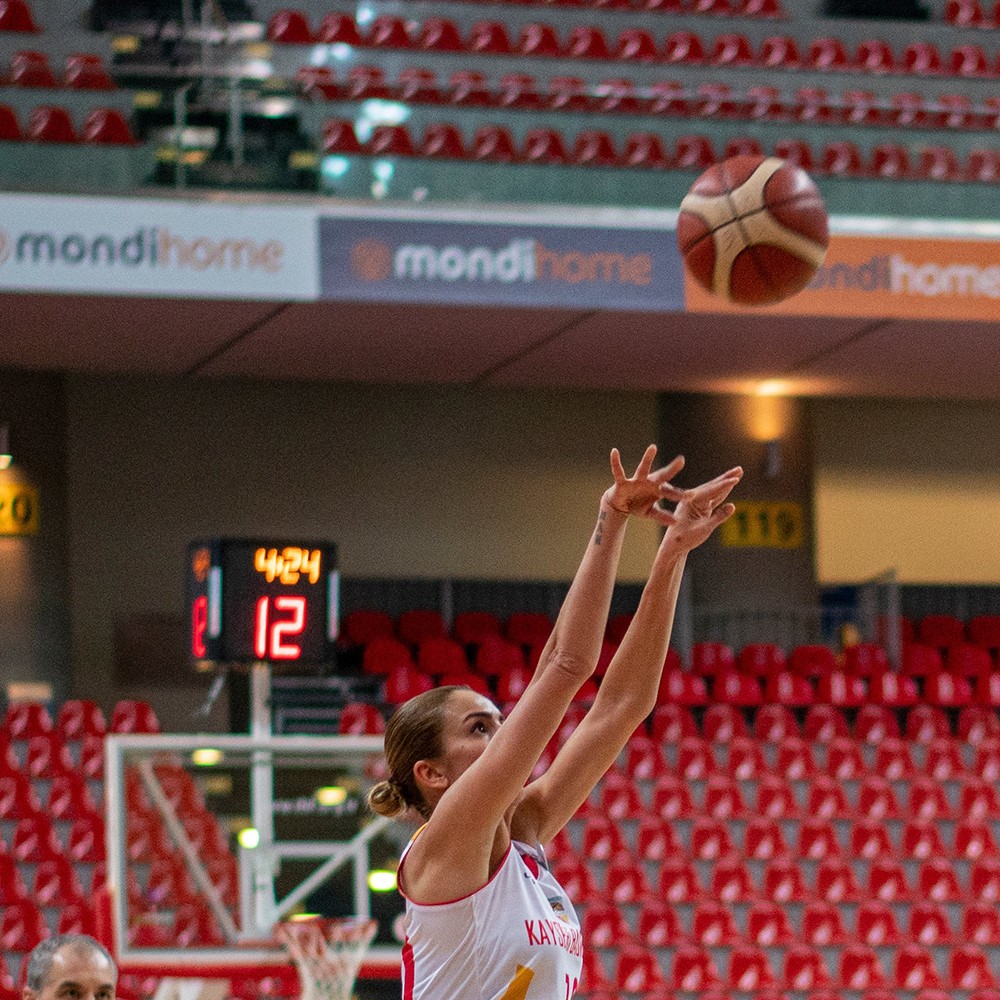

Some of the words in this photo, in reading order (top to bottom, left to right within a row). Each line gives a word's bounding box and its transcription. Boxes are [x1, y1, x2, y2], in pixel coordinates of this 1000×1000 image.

[15, 226, 284, 273] mondihome
[394, 238, 652, 285] mondihome
[255, 547, 321, 585] 4:24
[255, 596, 306, 659] 12
